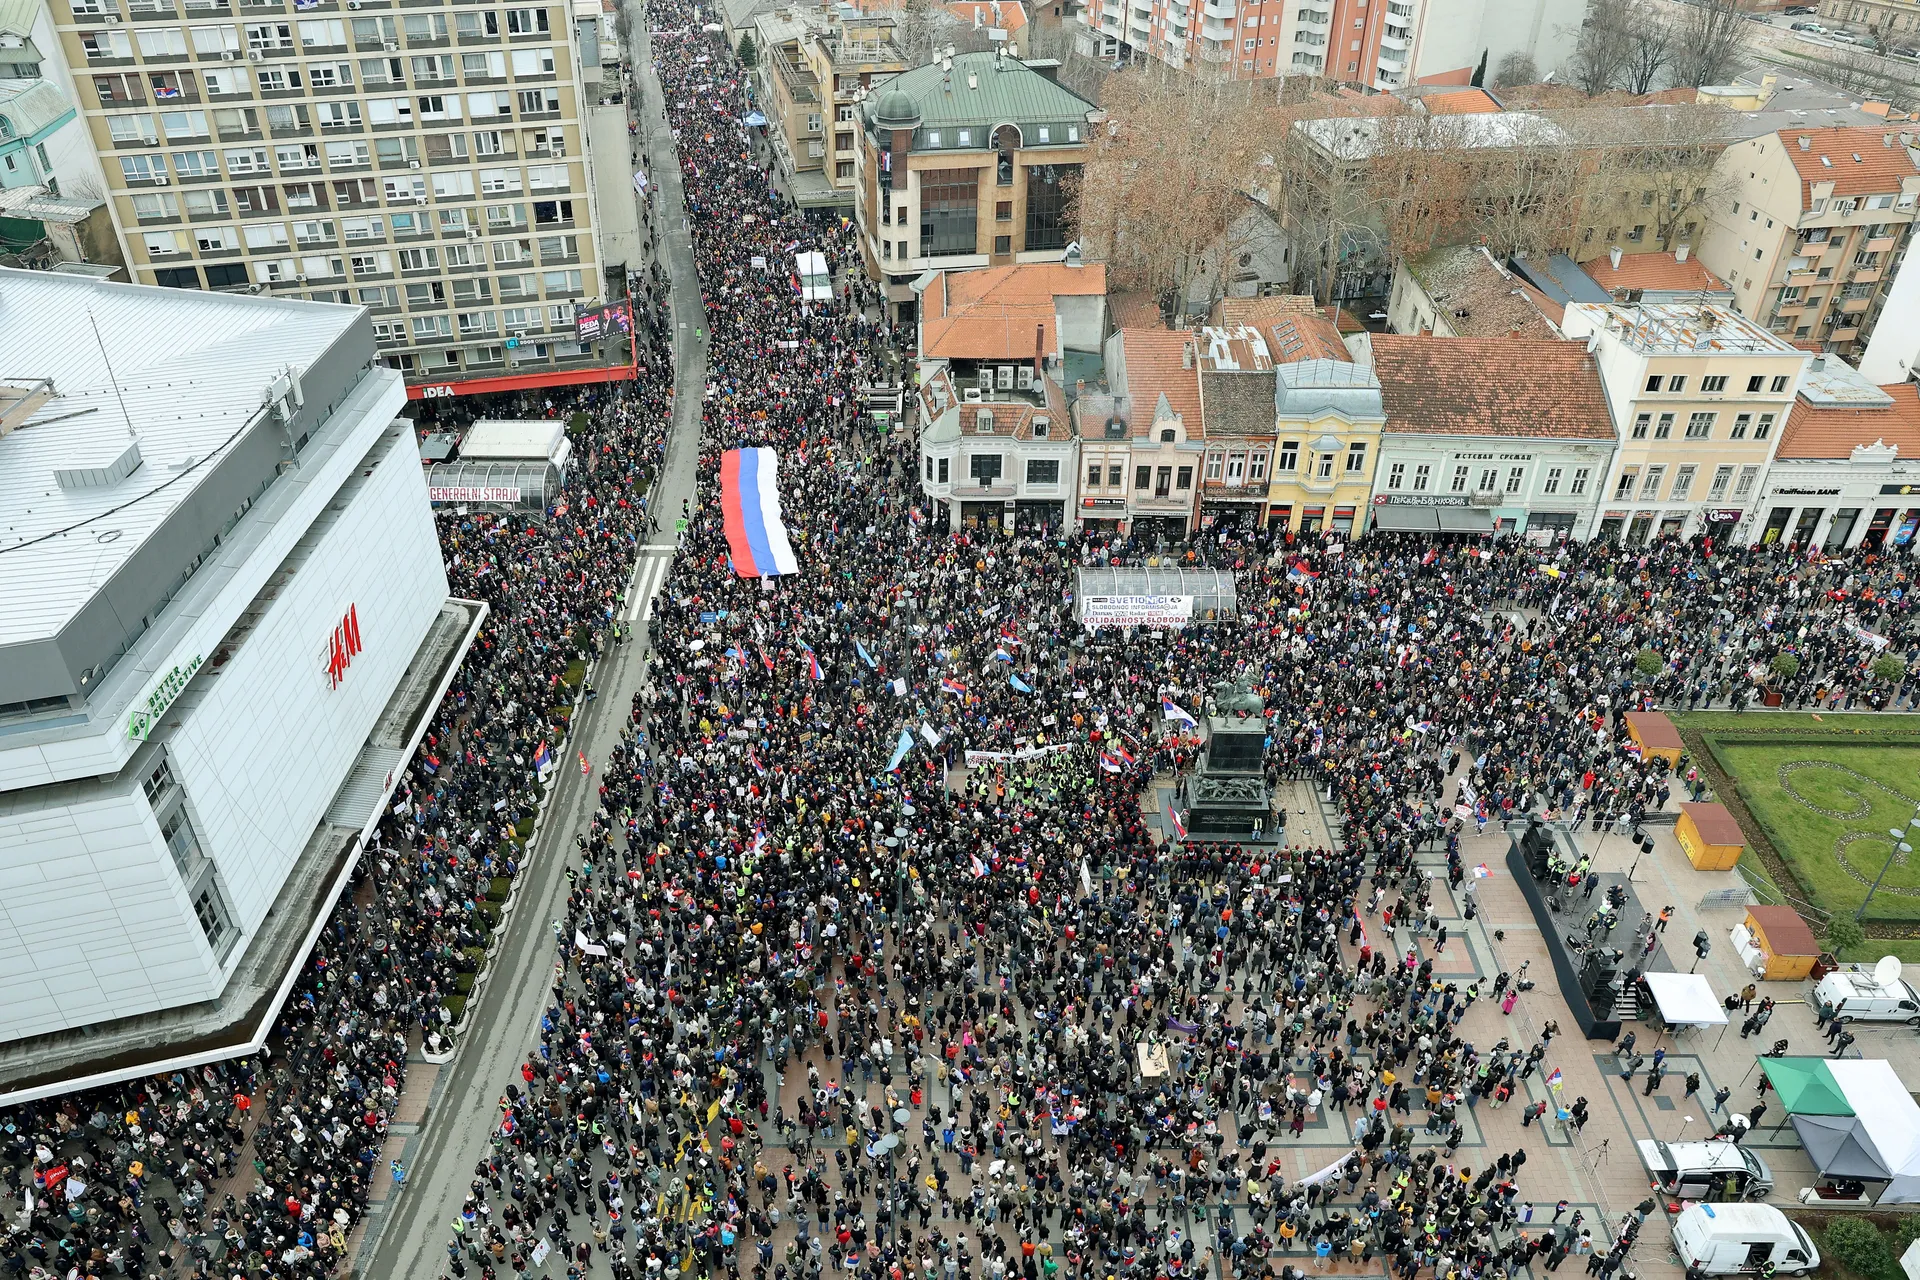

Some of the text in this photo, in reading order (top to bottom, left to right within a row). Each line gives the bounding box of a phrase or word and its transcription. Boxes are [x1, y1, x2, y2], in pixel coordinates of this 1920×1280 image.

[430, 487, 480, 500] GENERALNI
[328, 602, 362, 691] H&M
[148, 666, 180, 708] BETTER
[153, 654, 203, 718] COLLECTIVE
